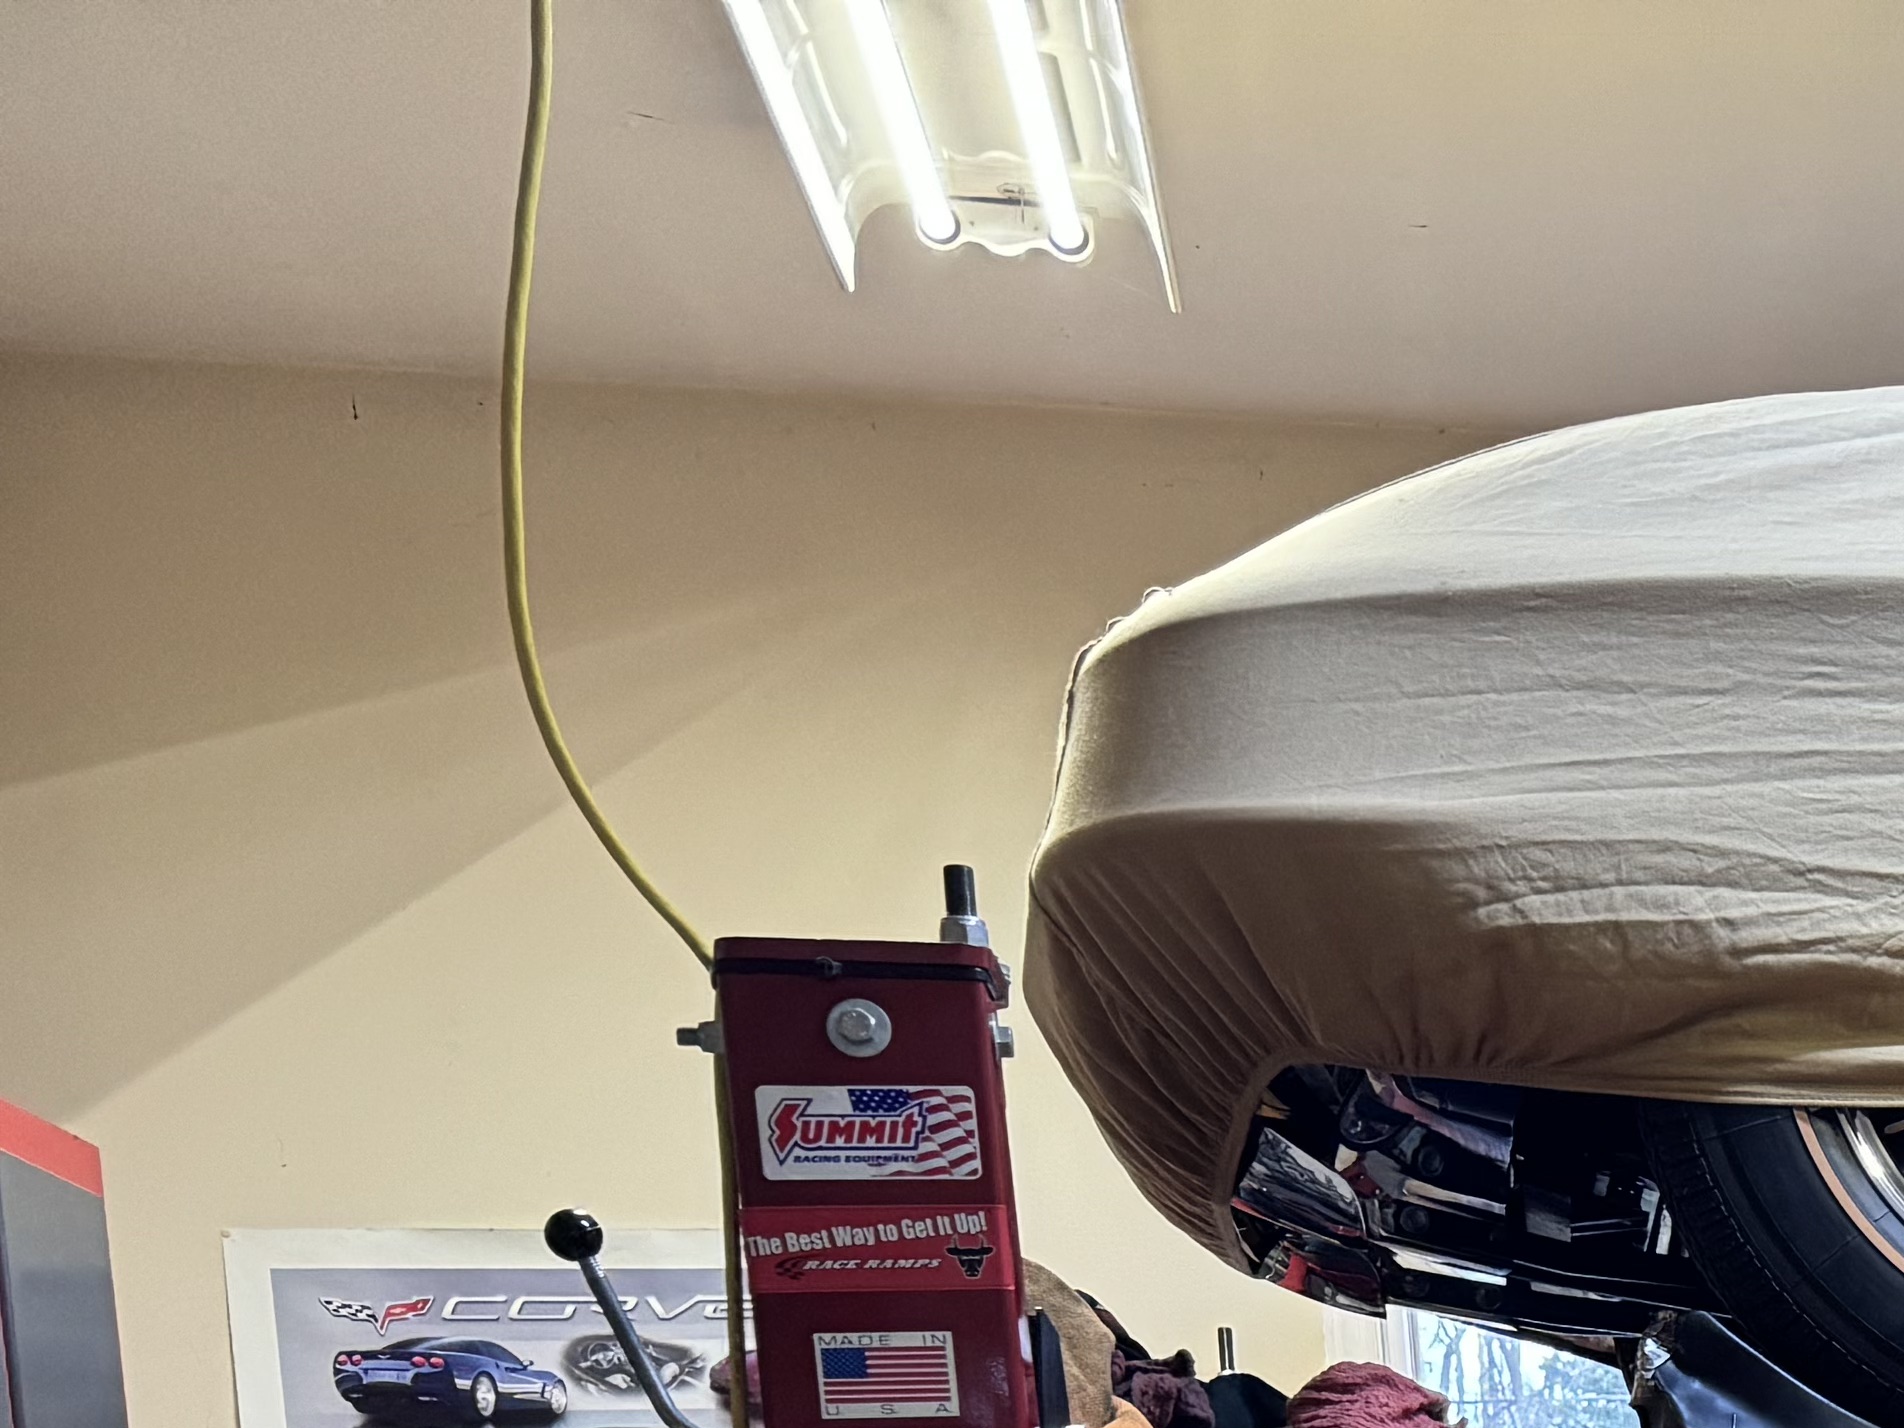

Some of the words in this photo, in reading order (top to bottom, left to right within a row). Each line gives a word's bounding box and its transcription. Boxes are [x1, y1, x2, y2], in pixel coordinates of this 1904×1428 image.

[793, 1154, 841, 1164] RACING
[844, 1153, 916, 1164] EQUIPMENT
[748, 1234, 782, 1257] The
[784, 1227, 828, 1252] Best
[831, 1223, 875, 1247] Way
[879, 1222, 899, 1242] to
[901, 1215, 935, 1240] Get
[936, 1214, 953, 1236] It
[953, 1210, 988, 1235] Up!
[803, 1258, 861, 1270] RACE
[863, 1257, 943, 1270] RAMPS
[817, 1334, 892, 1347] MADE
[922, 1332, 947, 1345] IN
[825, 1404, 840, 1417] U
[880, 1402, 897, 1414] S
[934, 1402, 951, 1414] A
